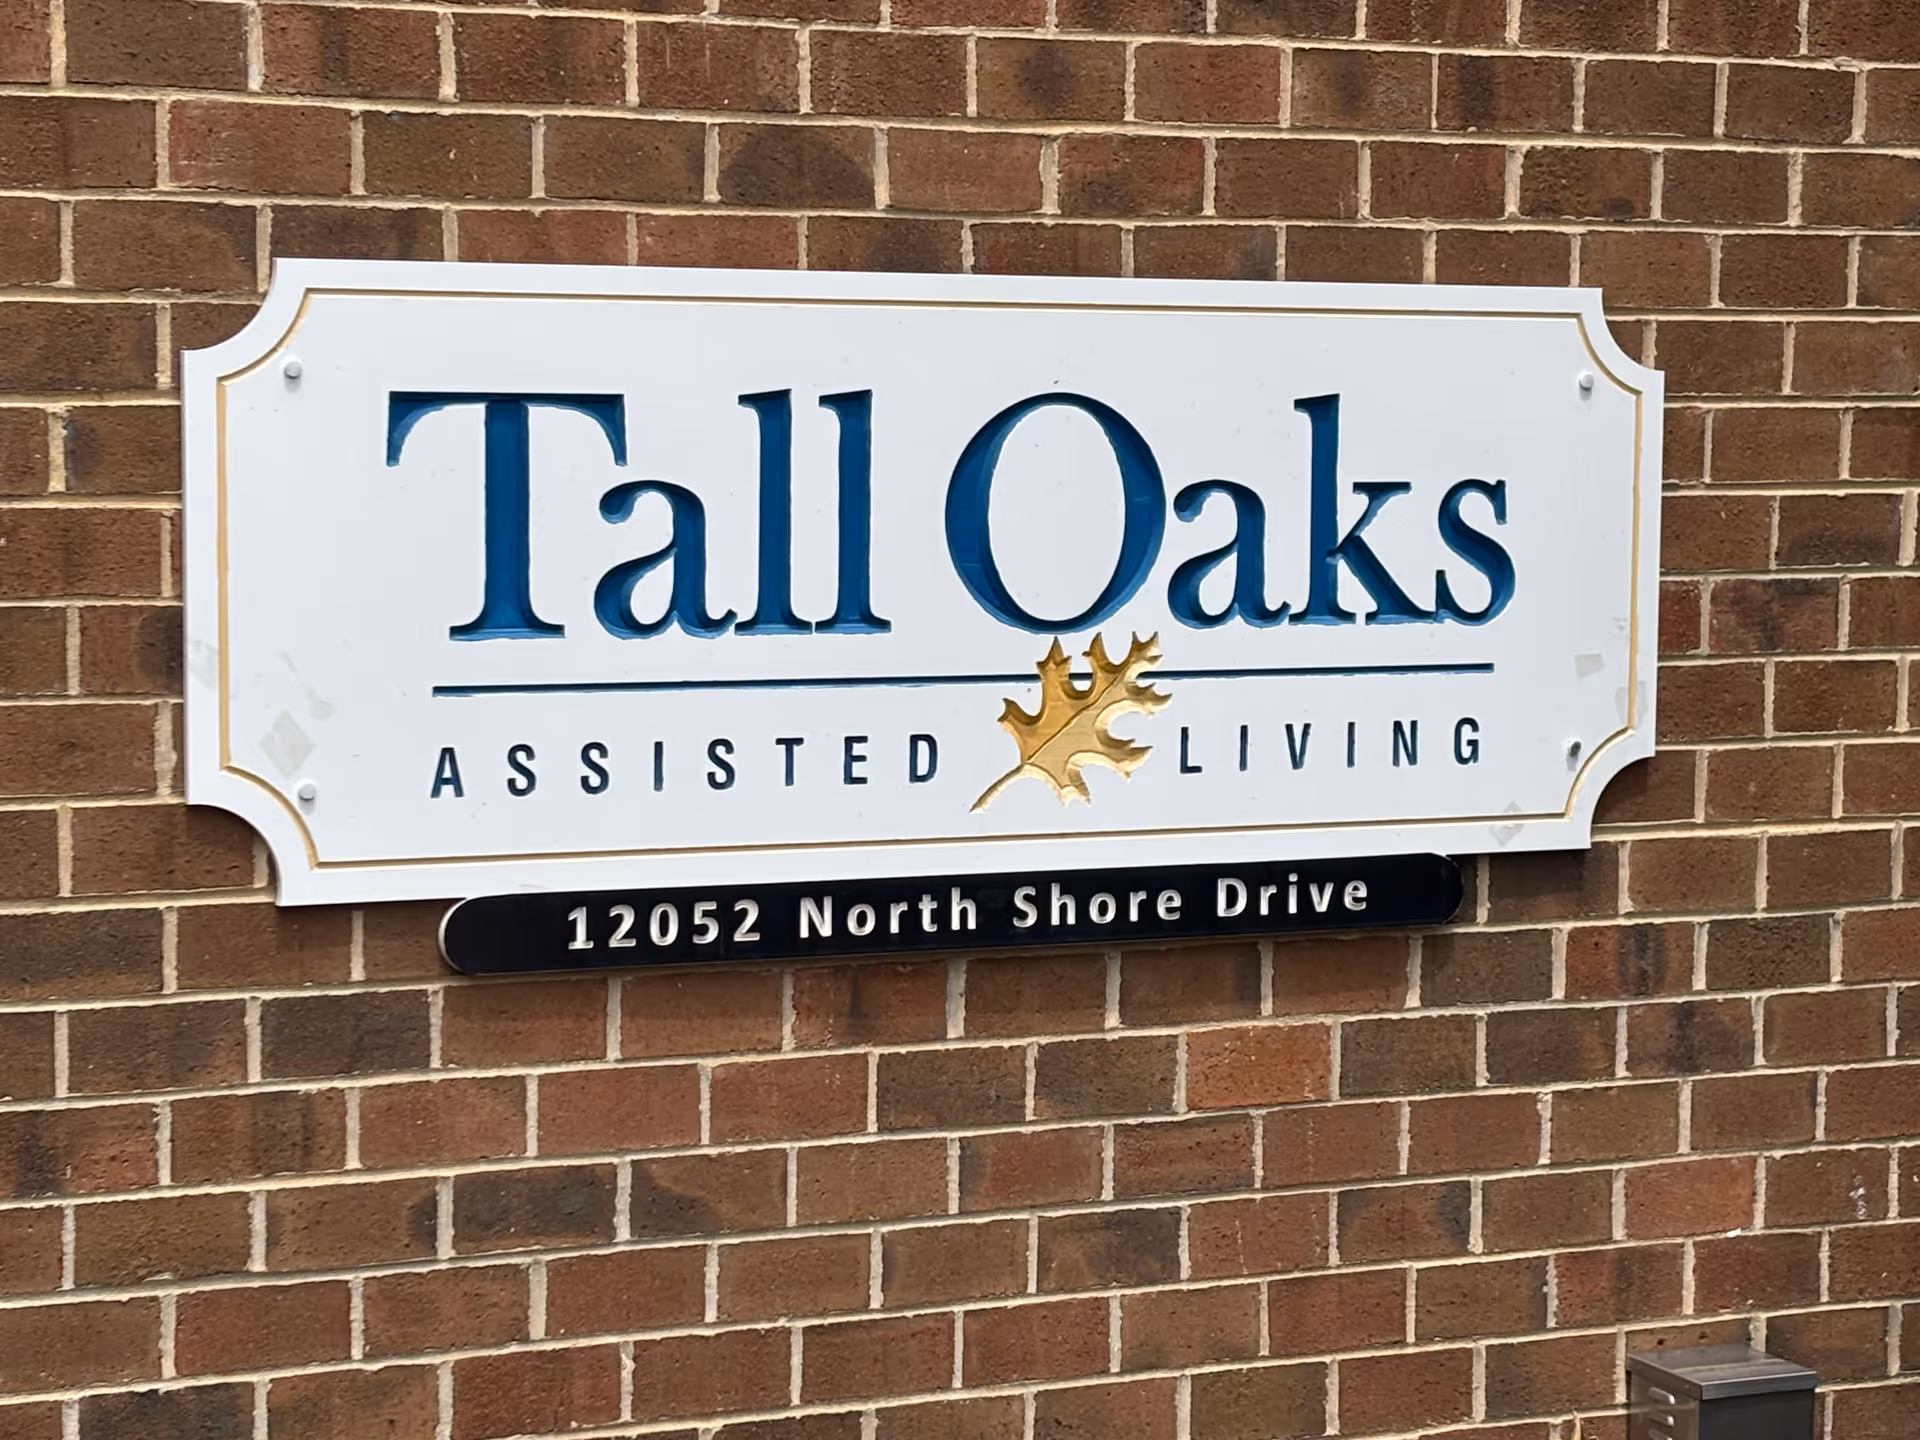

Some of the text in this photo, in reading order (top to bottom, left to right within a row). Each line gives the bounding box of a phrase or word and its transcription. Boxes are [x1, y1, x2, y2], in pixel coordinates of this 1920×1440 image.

[387, 390, 1517, 640] Tall Oaks
[431, 716, 1481, 798] ASSISTED LIVING
[566, 872, 1369, 951] 12052 North Shore Drive
